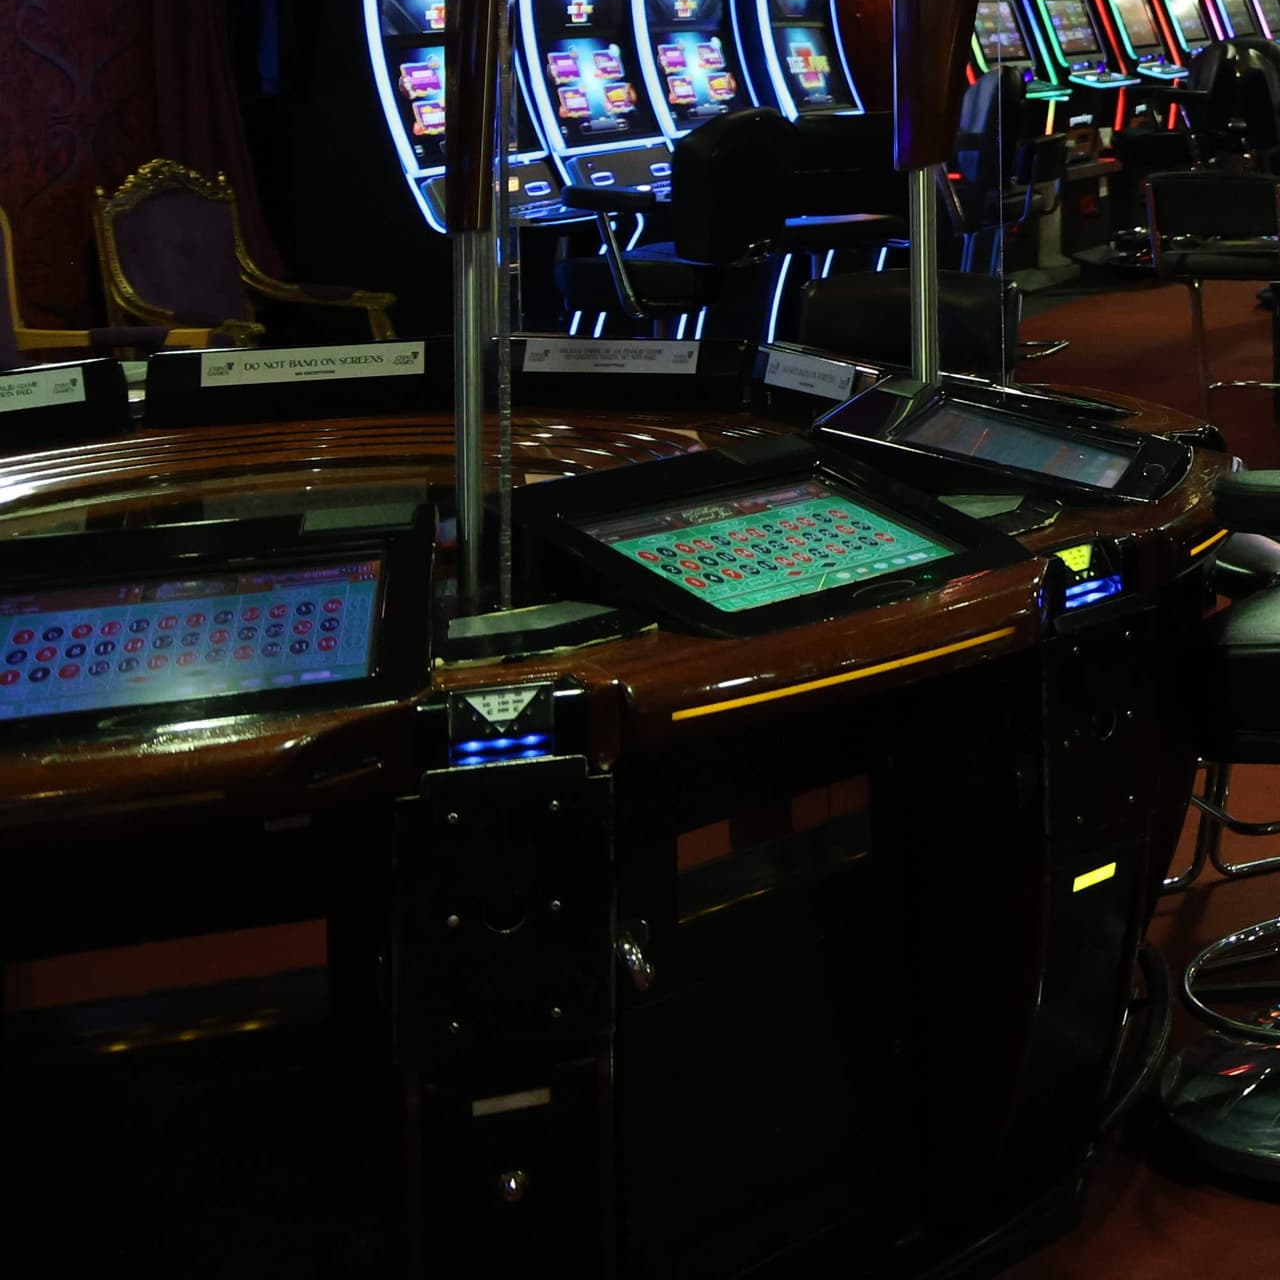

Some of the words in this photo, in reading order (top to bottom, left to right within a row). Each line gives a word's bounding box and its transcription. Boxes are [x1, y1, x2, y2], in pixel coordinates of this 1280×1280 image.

[244, 362, 260, 371] DO
[264, 360, 286, 369] NOT
[289, 358, 318, 368] BANG
[321, 357, 336, 366] ON
[338, 355, 384, 365] SCREENS
